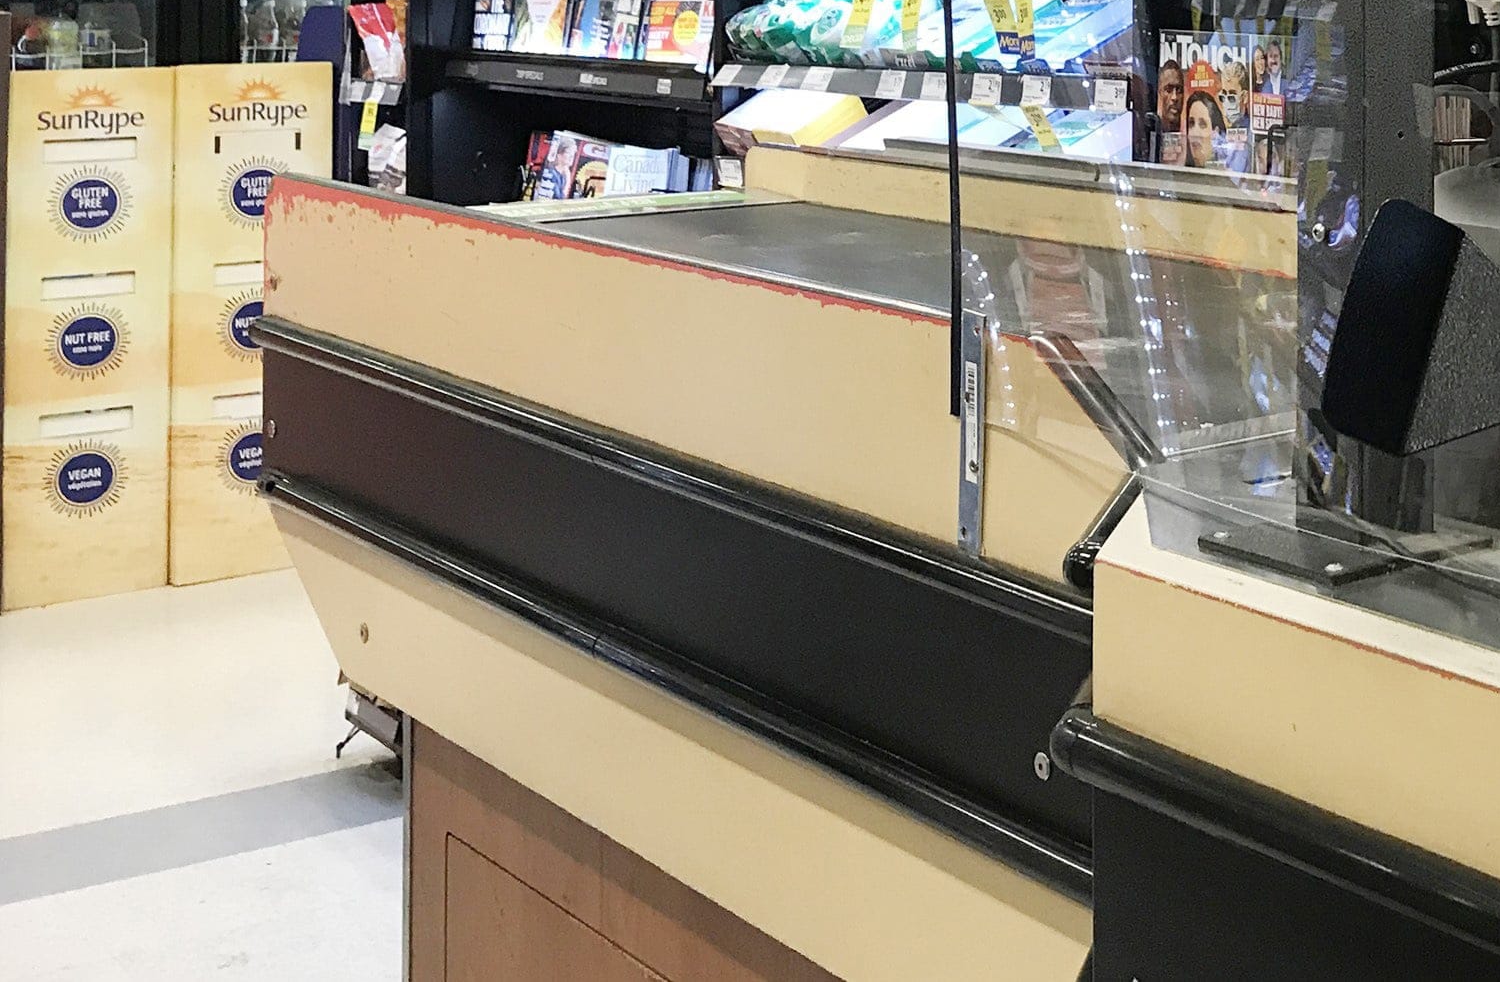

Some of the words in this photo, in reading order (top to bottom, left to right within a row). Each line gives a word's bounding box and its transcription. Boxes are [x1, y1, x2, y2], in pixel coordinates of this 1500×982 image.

[208, 101, 308, 126] SunRype
[37, 109, 145, 135] SunRype
[240, 176, 273, 188] GLUTE
[71, 186, 110, 200] GLUTEN
[78, 198, 103, 209] FREE
[64, 332, 87, 345] NUT
[88, 329, 111, 343] FREE
[239, 448, 263, 460] VEGA
[68, 466, 102, 481] VEGAN
